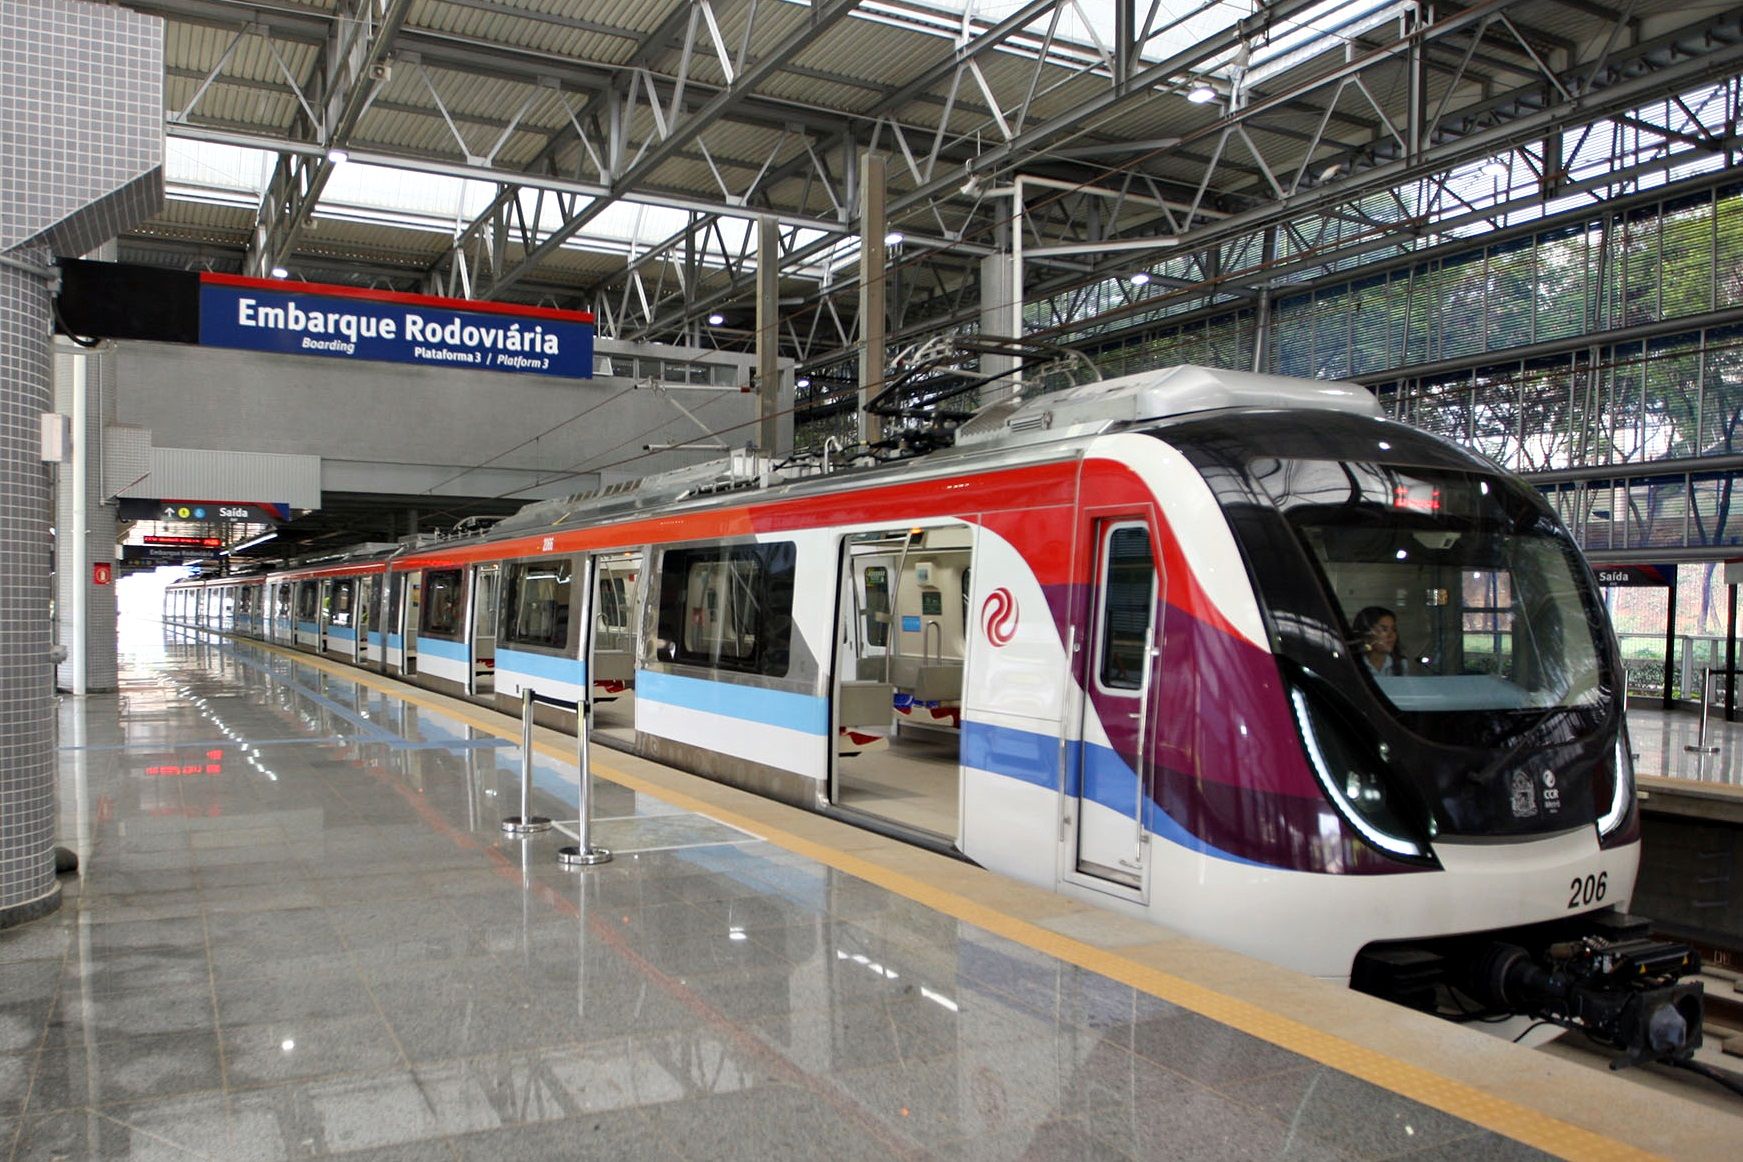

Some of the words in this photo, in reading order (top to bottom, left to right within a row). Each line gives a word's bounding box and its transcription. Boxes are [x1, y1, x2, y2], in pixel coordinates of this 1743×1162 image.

[238, 297, 397, 343] Embarque
[405, 313, 559, 355] Rodoviária
[302, 336, 355, 355] Boarding
[414, 346, 474, 362] Plataforma
[474, 352, 482, 363] 3
[485, 352, 492, 365] /
[497, 353, 541, 369] Platform
[542, 358, 549, 369] 3
[219, 506, 248, 518] Saída
[1599, 571, 1629, 581] Saída
[1568, 871, 1608, 909] 206
